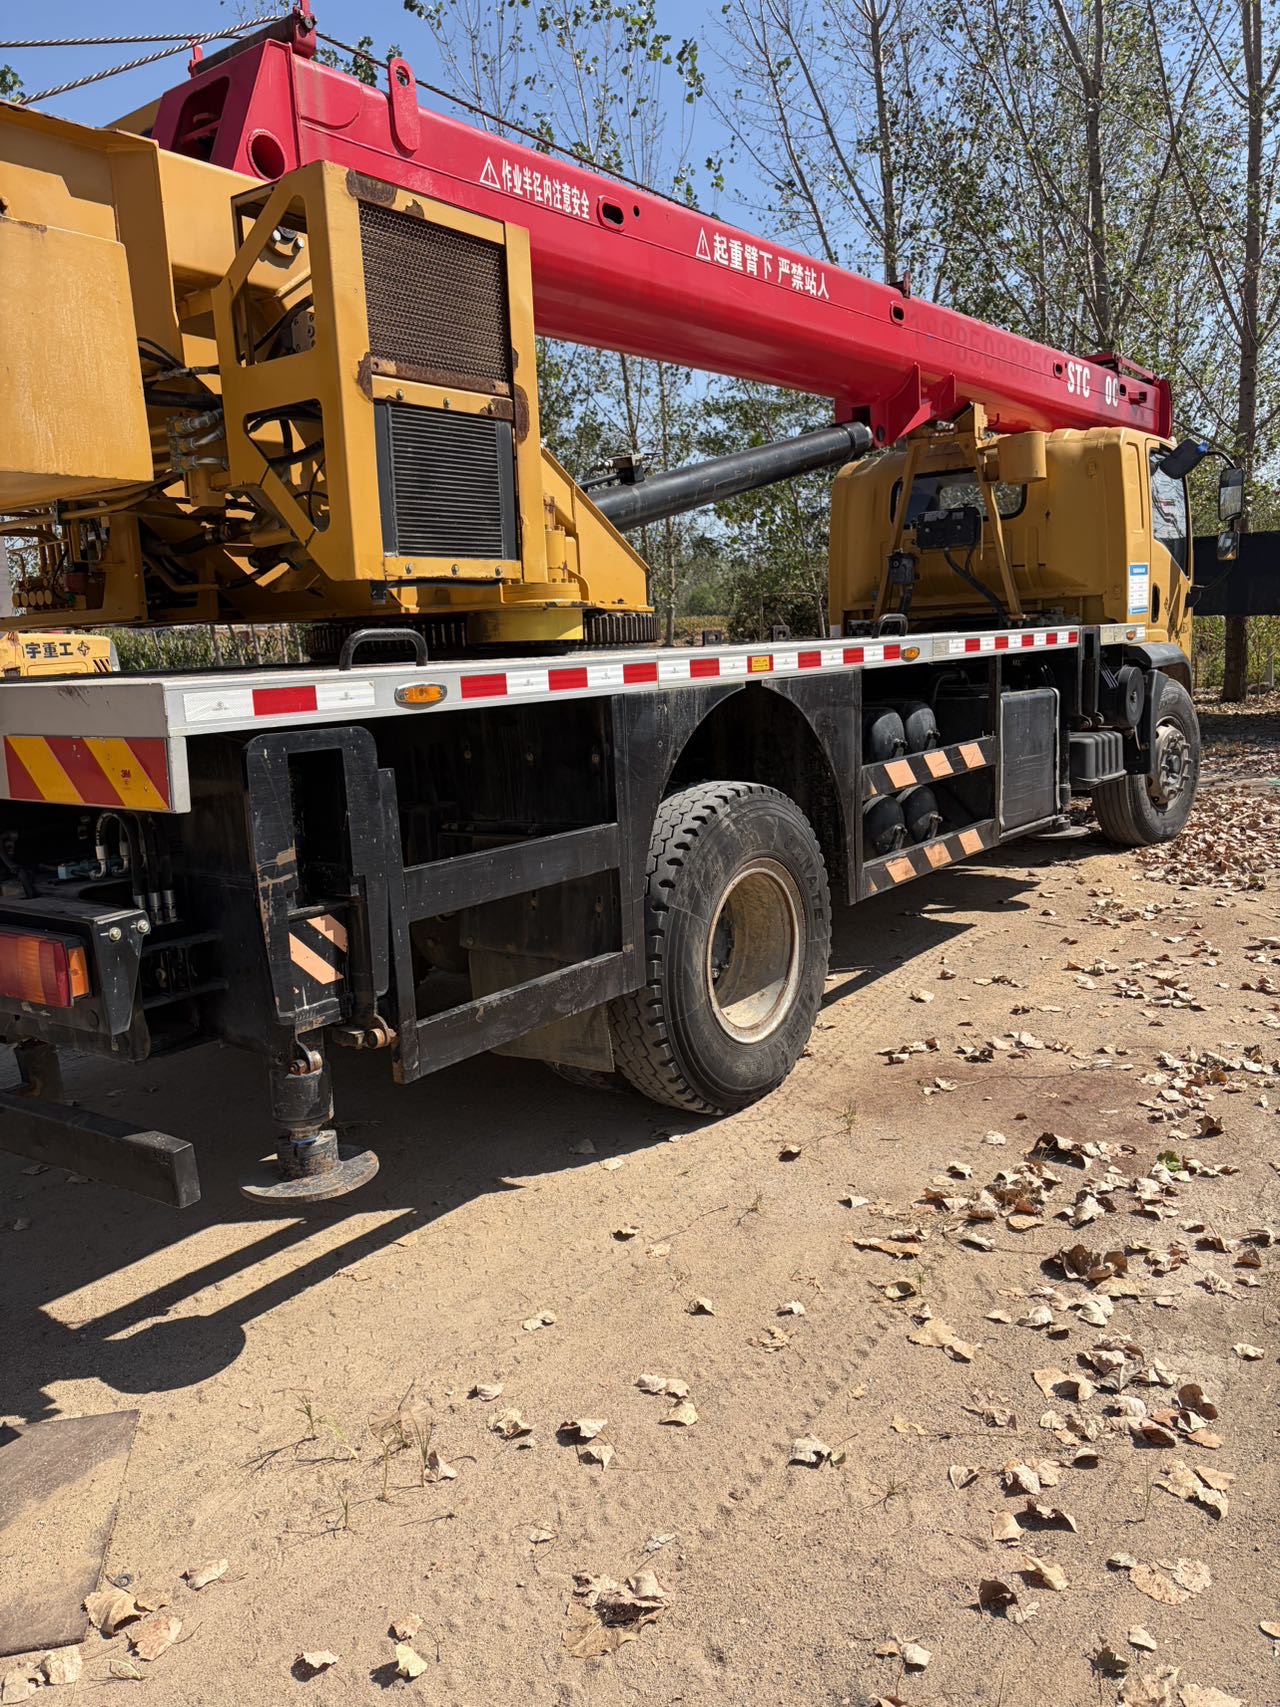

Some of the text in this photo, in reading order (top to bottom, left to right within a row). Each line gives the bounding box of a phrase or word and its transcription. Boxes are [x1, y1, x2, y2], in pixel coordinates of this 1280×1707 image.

[502, 158, 590, 219] 作业半径内注意安全
[713, 232, 829, 299] 起重臂下 严禁站人
[1067, 361, 1090, 398] STC
[121, 769, 132, 779] 3M
